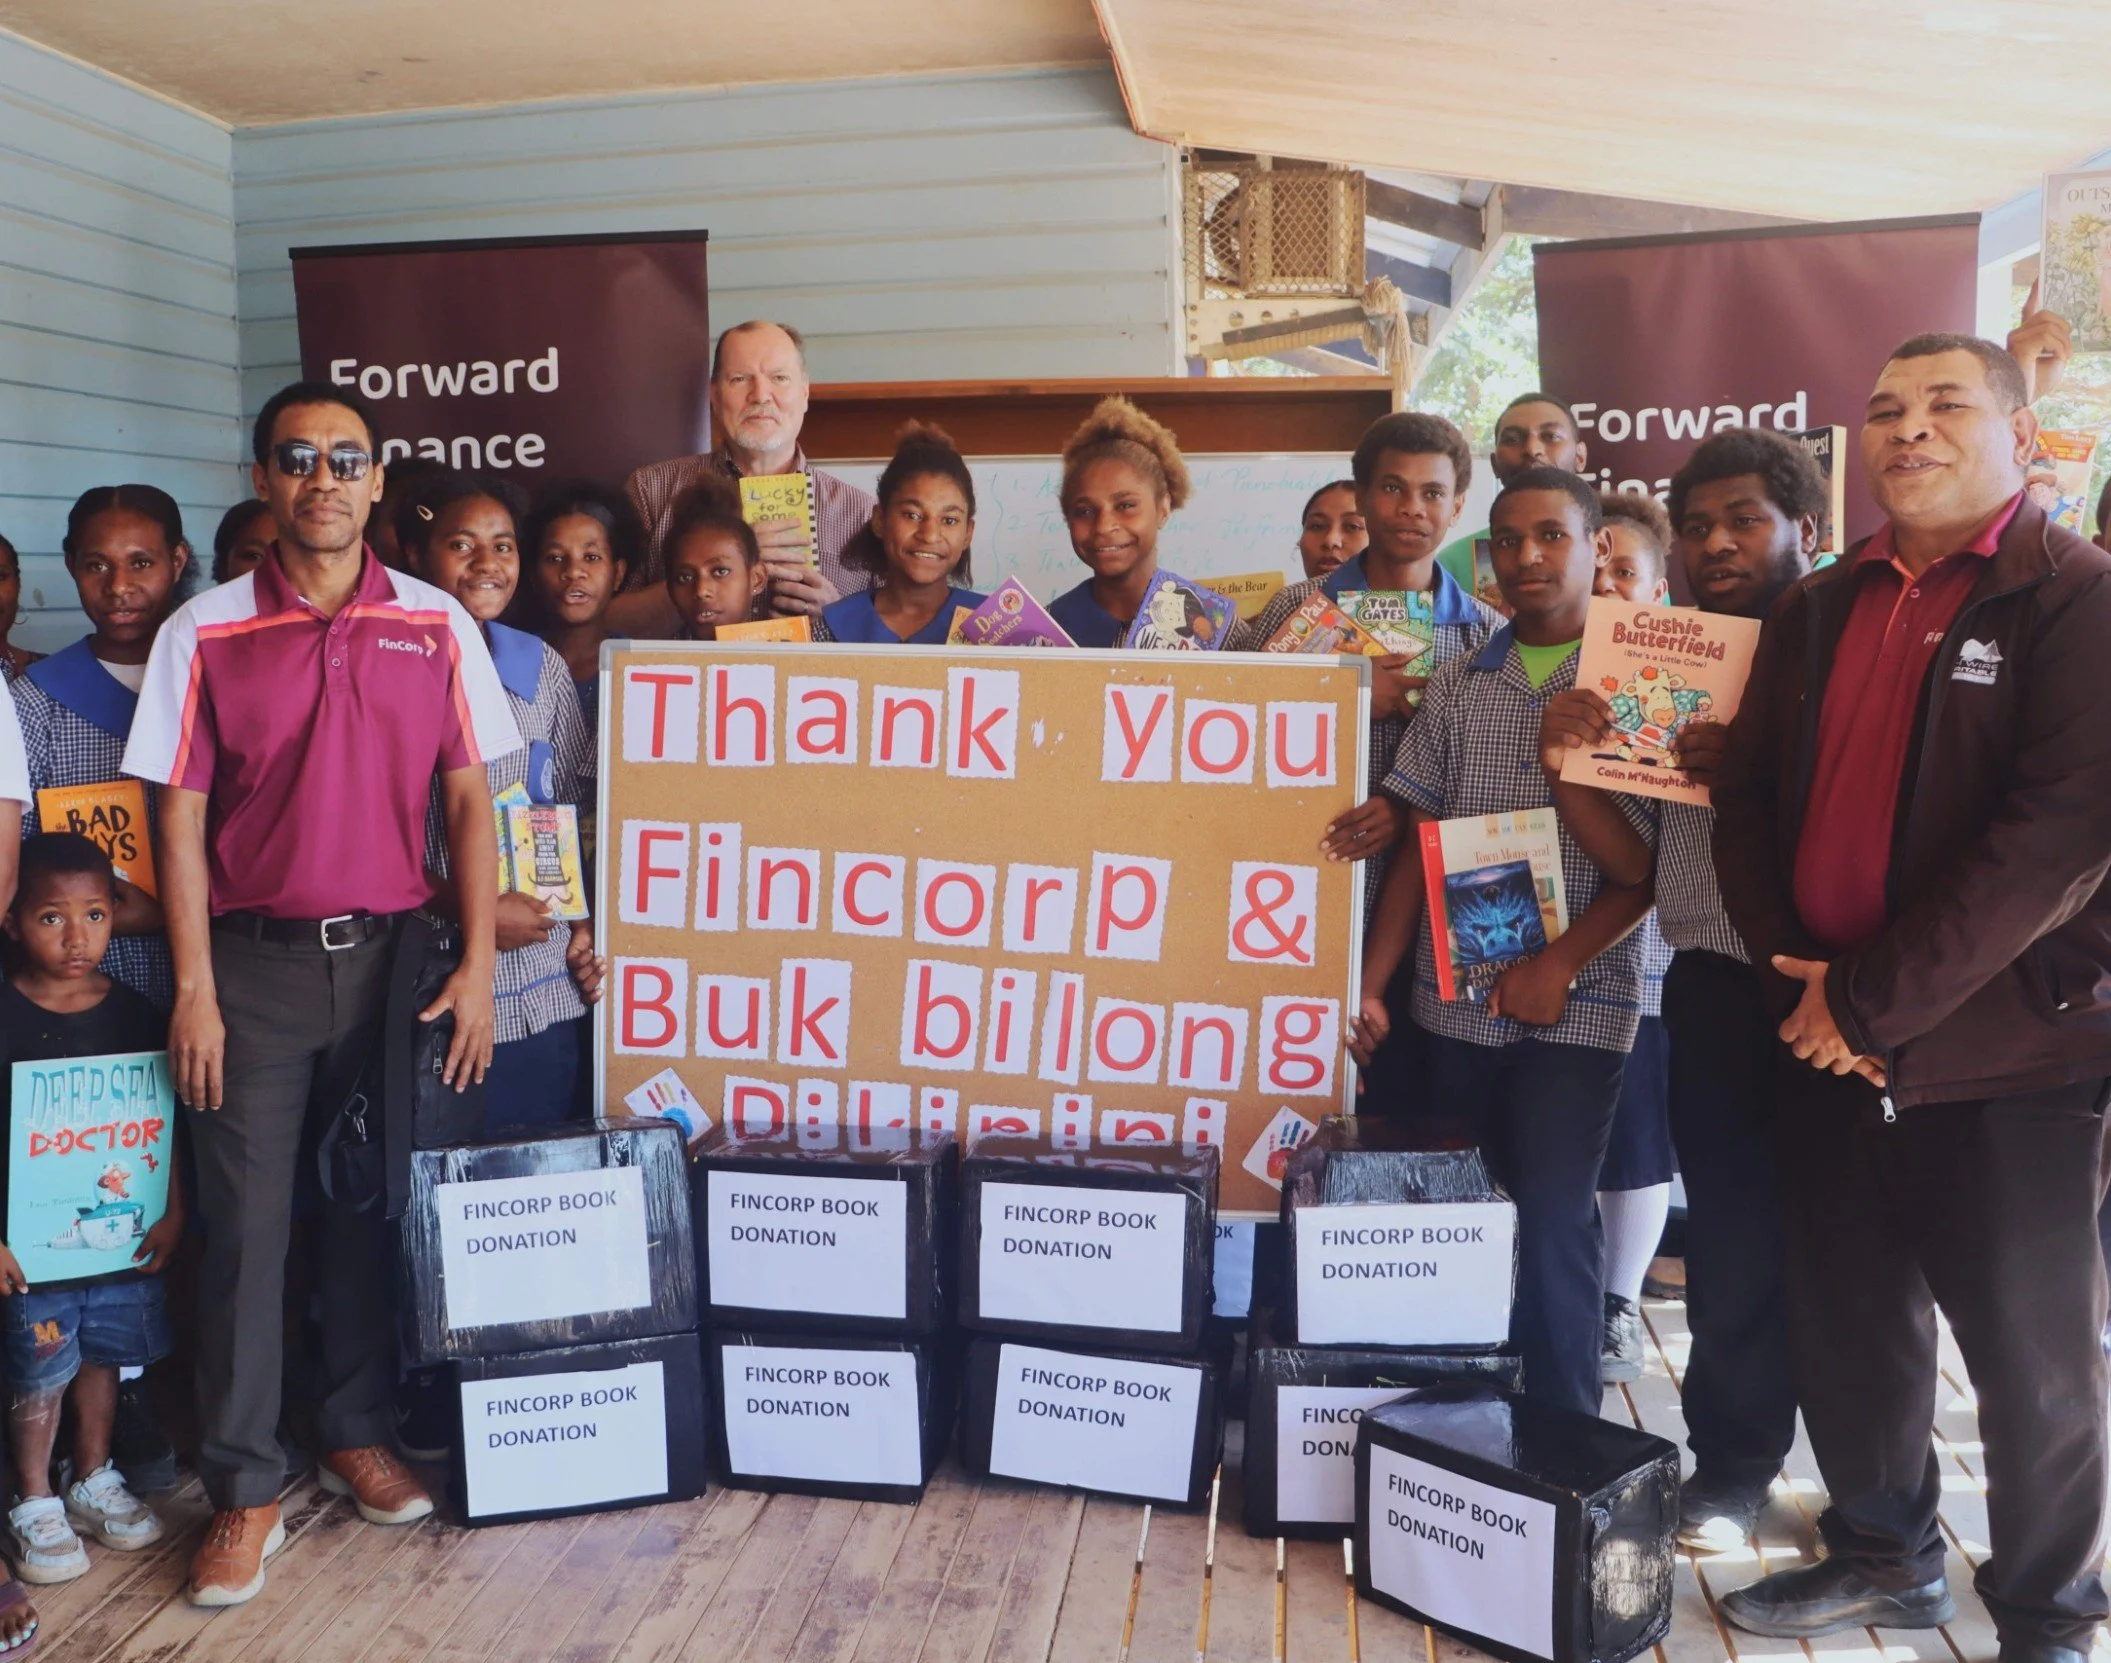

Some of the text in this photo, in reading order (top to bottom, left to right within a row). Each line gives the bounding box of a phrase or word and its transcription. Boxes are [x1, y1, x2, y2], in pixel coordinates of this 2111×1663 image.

[2067, 187, 2111, 202] OUTS
[330, 346, 559, 400] Forward
[381, 433, 546, 470] nance
[1228, 581, 1243, 594] the
[1245, 580, 1268, 592] Bear
[1361, 608, 1406, 621] GATES
[1369, 597, 1401, 609] TOM
[974, 609, 1003, 634] Dog
[1632, 611, 1704, 637] Cushie
[1268, 630, 1301, 653] Pony
[1611, 621, 1727, 662] Butterfield
[1660, 651, 1682, 665] Little
[1684, 657, 1708, 668] Cow)
[630, 669, 1329, 779] Thank you
[1596, 766, 1627, 780] Colin
[66, 804, 131, 836] BAD
[1473, 850, 1500, 866] Town
[636, 829, 1312, 964] Fincorp &
[1469, 953, 1537, 978] DRAGO
[622, 964, 1330, 1090] Buk bilong
[31, 1060, 162, 1127] DEEP SEA
[29, 1118, 165, 1158] DOCTOR
[463, 1190, 617, 1221] FINCORP BOOK
[730, 1193, 880, 1217] FINCORP BOOK
[1003, 1205, 1158, 1230] FINCORP BOOK
[466, 1228, 577, 1255] DONATION
[730, 1225, 837, 1247] DONATION
[1002, 1237, 1113, 1260] DONATION
[1321, 1226, 1485, 1246] FINCORP BOOK
[1321, 1261, 1438, 1280] DONATION
[34, 1320, 62, 1344] M
[745, 1366, 891, 1388] FINCORP BOOK
[1020, 1367, 1173, 1403] FINCORP BOOK
[486, 1385, 638, 1417] FINCORP BOOK
[746, 1398, 851, 1418] DONATION
[1018, 1398, 1127, 1428] DONATION
[1302, 1407, 1365, 1424] FINCO
[488, 1422, 598, 1449] DONATION
[1388, 1472, 1529, 1539] FINCORP BOOK
[1387, 1508, 1486, 1561] DONATION
